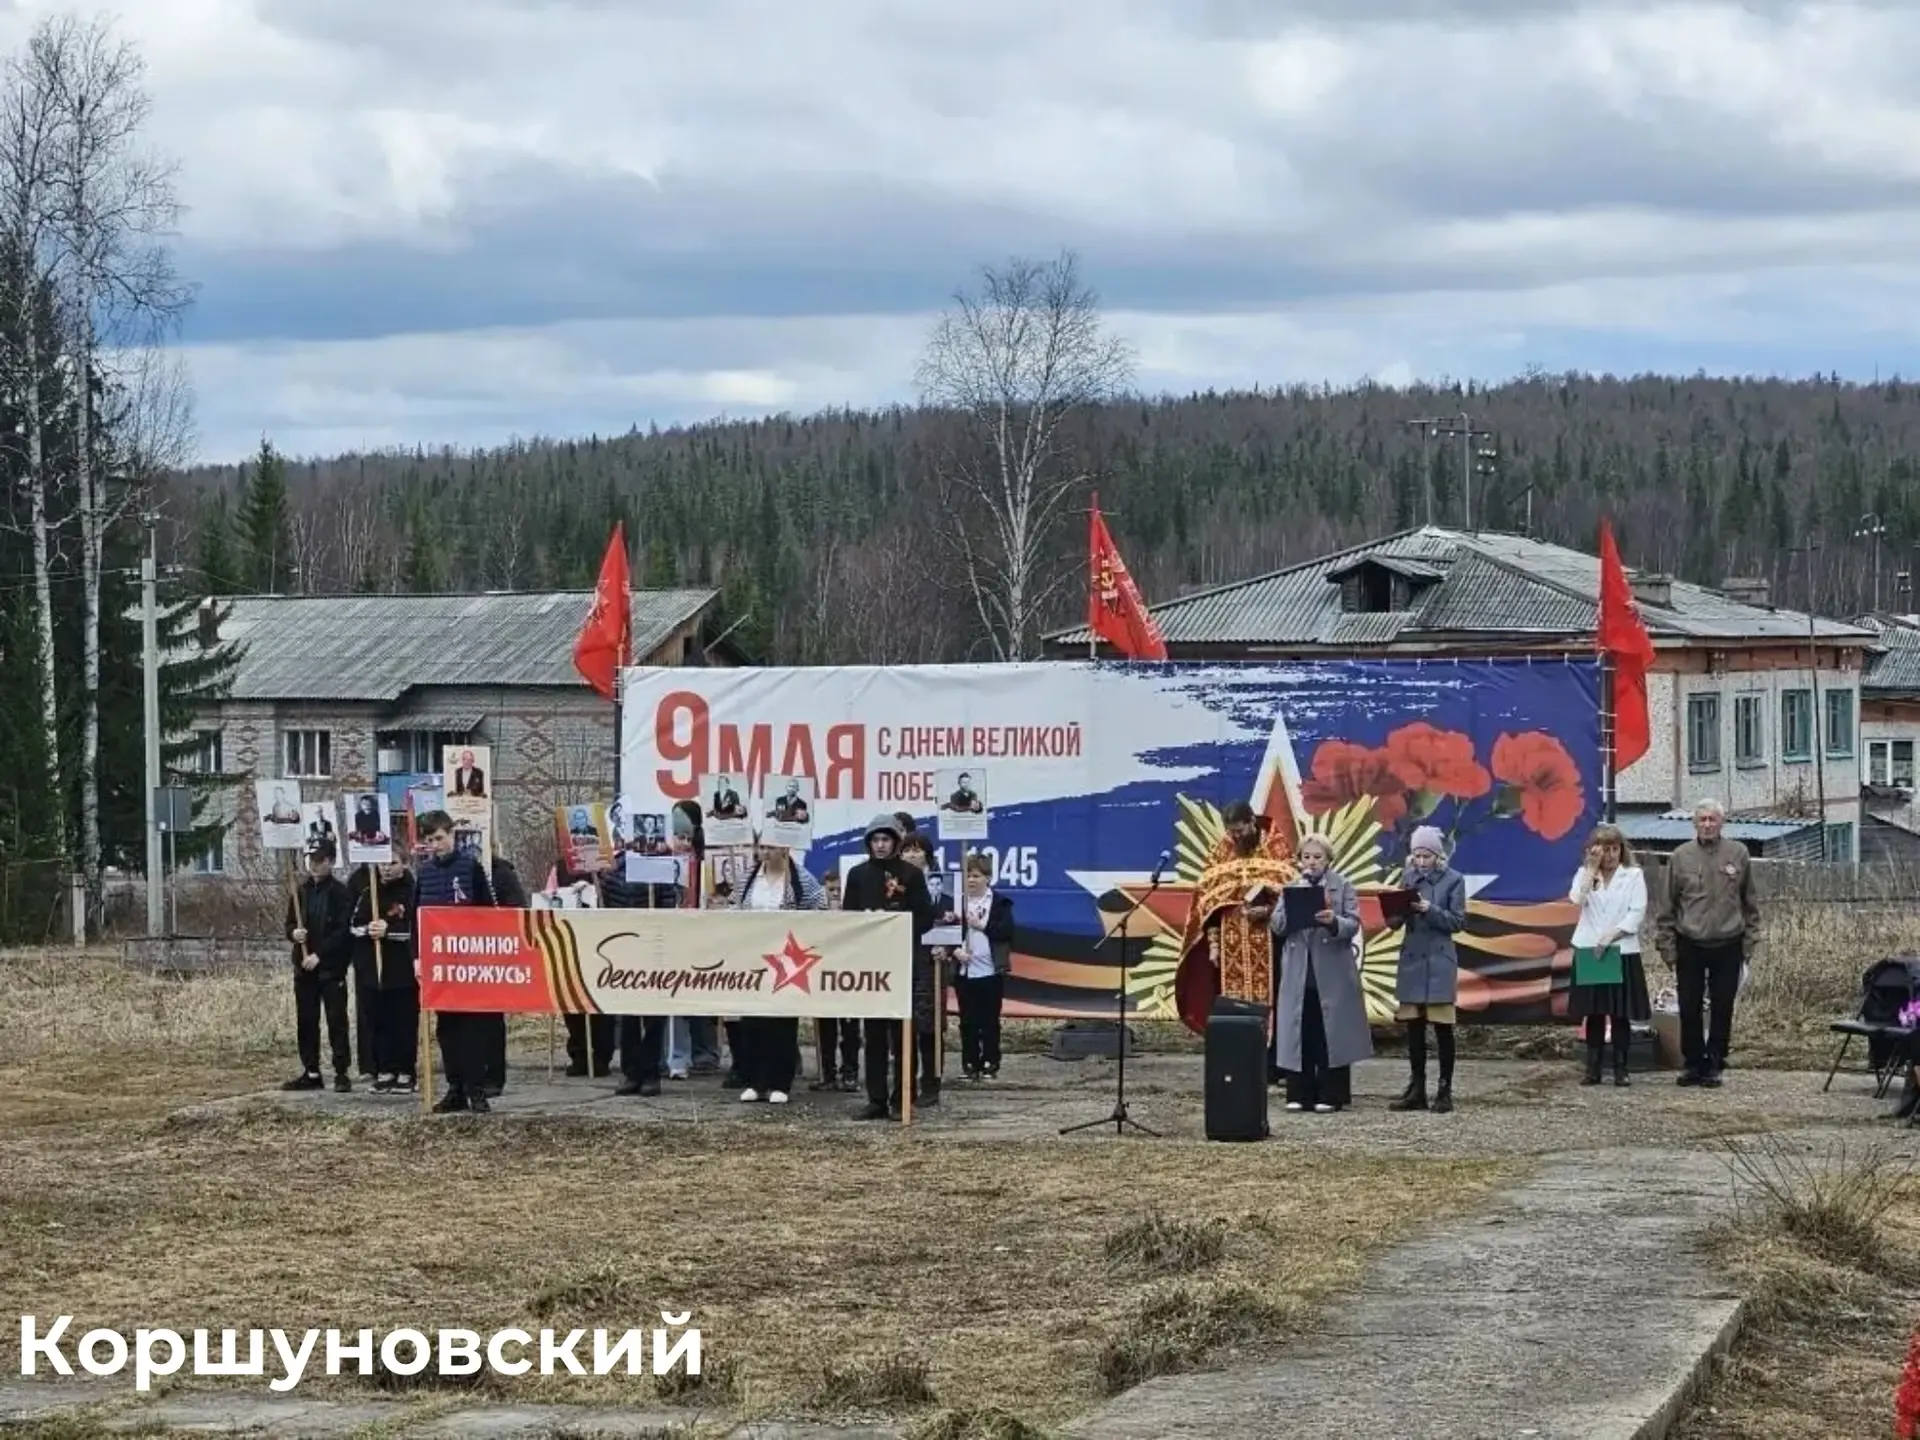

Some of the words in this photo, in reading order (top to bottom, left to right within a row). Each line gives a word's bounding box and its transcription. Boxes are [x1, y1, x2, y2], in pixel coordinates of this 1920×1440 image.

[655, 690, 709, 800] 9
[718, 723, 866, 800] МАЯ
[877, 726, 892, 757] С
[896, 726, 965, 760] ДНЕМ
[972, 721, 1081, 757] ВЕЛИКОЙ
[878, 771, 938, 804] ПОБЕ
[431, 934, 443, 953] Я
[446, 935, 520, 955] ПОМНЮ!
[431, 964, 443, 983] Я
[446, 964, 532, 984] ГОРЖУСЬ!
[819, 969, 893, 994] ПОЛК
